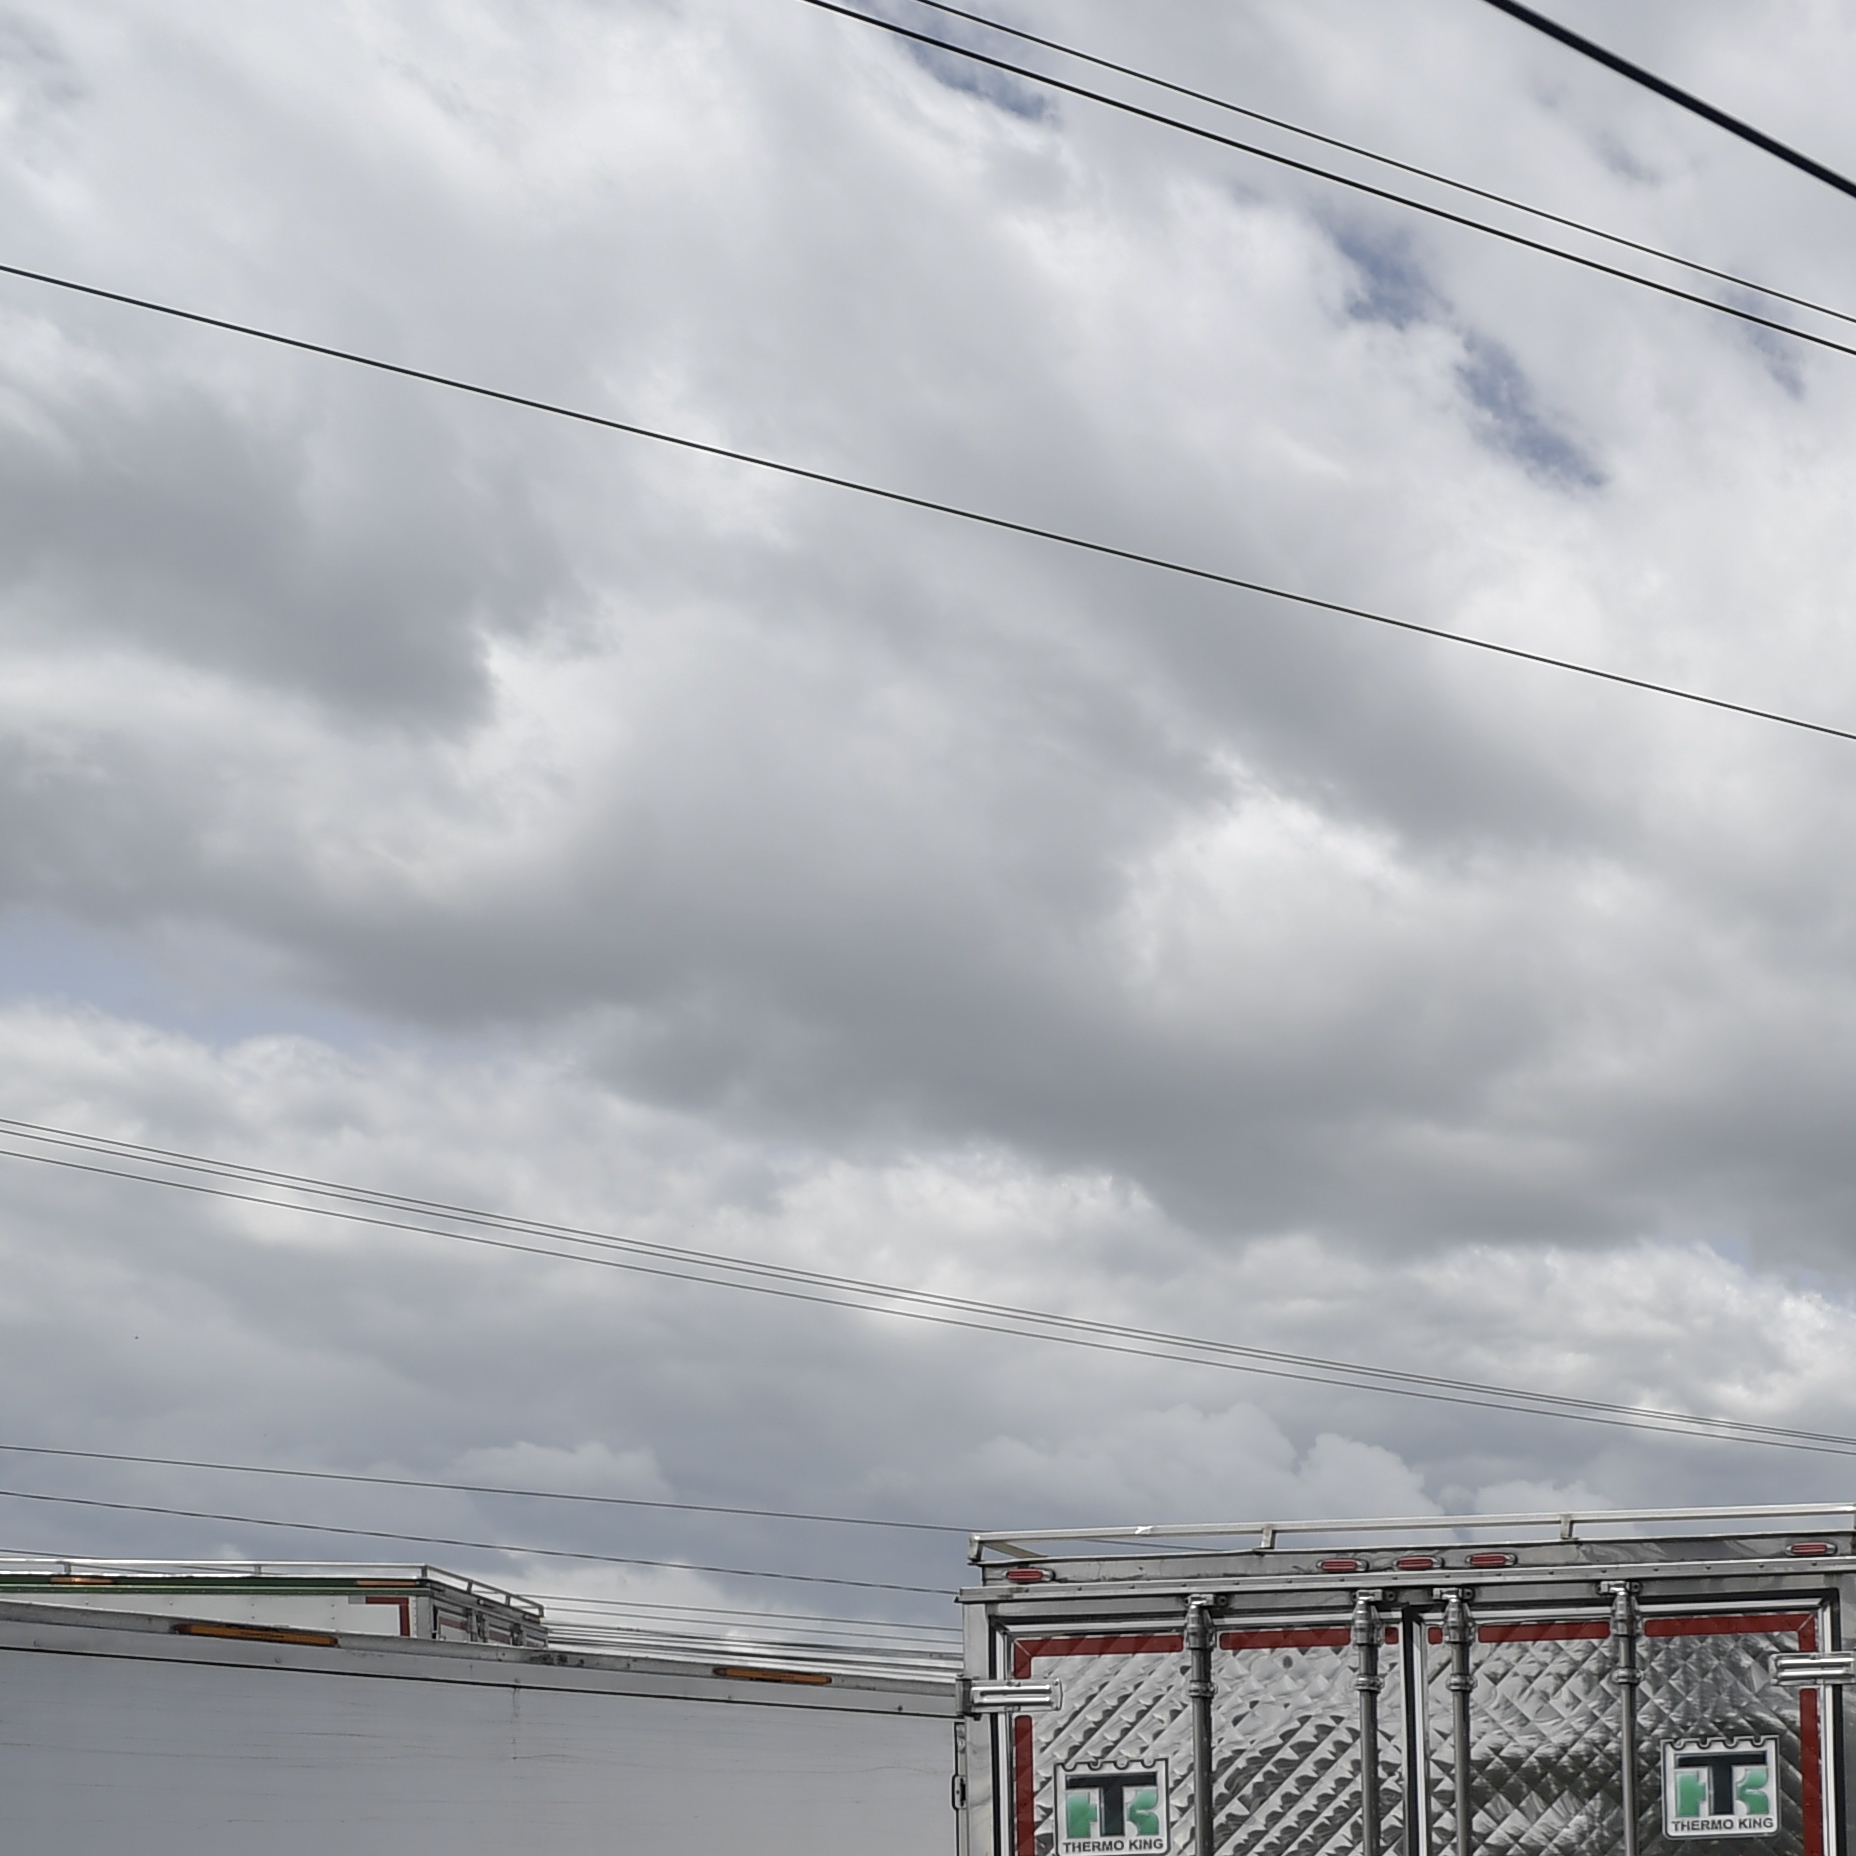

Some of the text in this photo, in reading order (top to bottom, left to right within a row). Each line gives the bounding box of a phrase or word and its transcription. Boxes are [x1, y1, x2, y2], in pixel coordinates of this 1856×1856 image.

[1671, 1818, 1774, 1832] THERMO KING
[1062, 1838, 1164, 1854] THERMO KING
